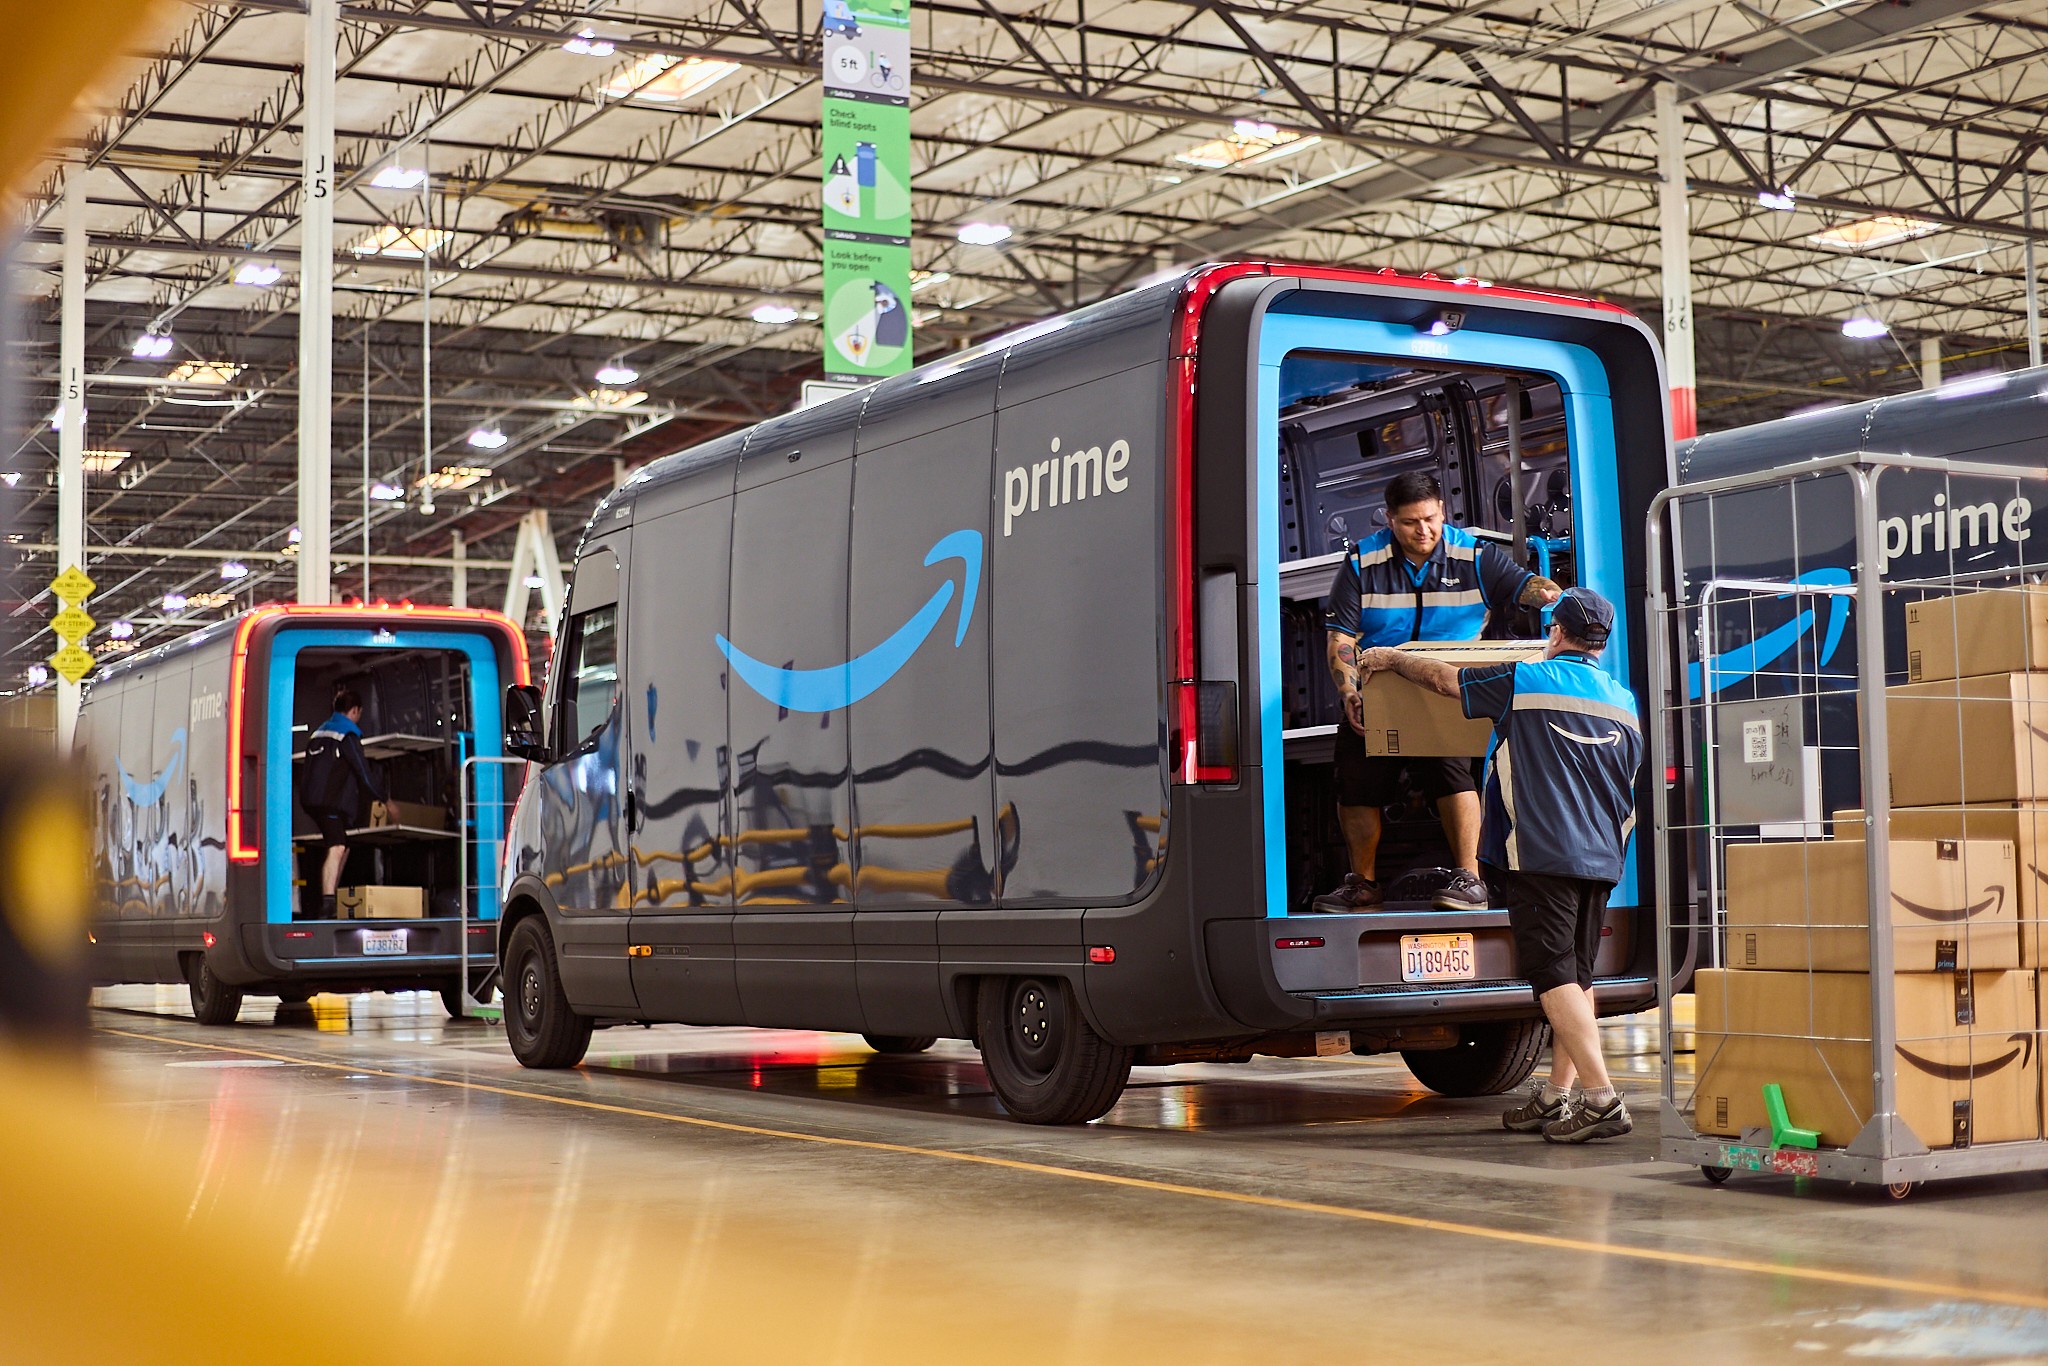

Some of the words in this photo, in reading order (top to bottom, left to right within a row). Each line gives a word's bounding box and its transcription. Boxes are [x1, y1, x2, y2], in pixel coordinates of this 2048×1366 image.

[841, 58, 847, 68] 5
[850, 60, 858, 70] ft
[830, 109, 856, 119] Check
[830, 119, 851, 129] blind
[853, 123, 877, 132] spots
[314, 179, 327, 198] 5
[831, 251, 850, 260] Look
[854, 253, 883, 263] before
[831, 262, 847, 270] you
[849, 263, 870, 272] open
[1668, 316, 1675, 332] 6
[1680, 315, 1687, 330] 6
[69, 385, 78, 400] 5
[1004, 437, 1131, 537] prime
[1878, 493, 2032, 575] prime
[191, 685, 222, 733] prime
[1407, 942, 1446, 950] WASHINGTON
[1407, 950, 1470, 974] D18945C
[1937, 960, 1955, 969] prime
